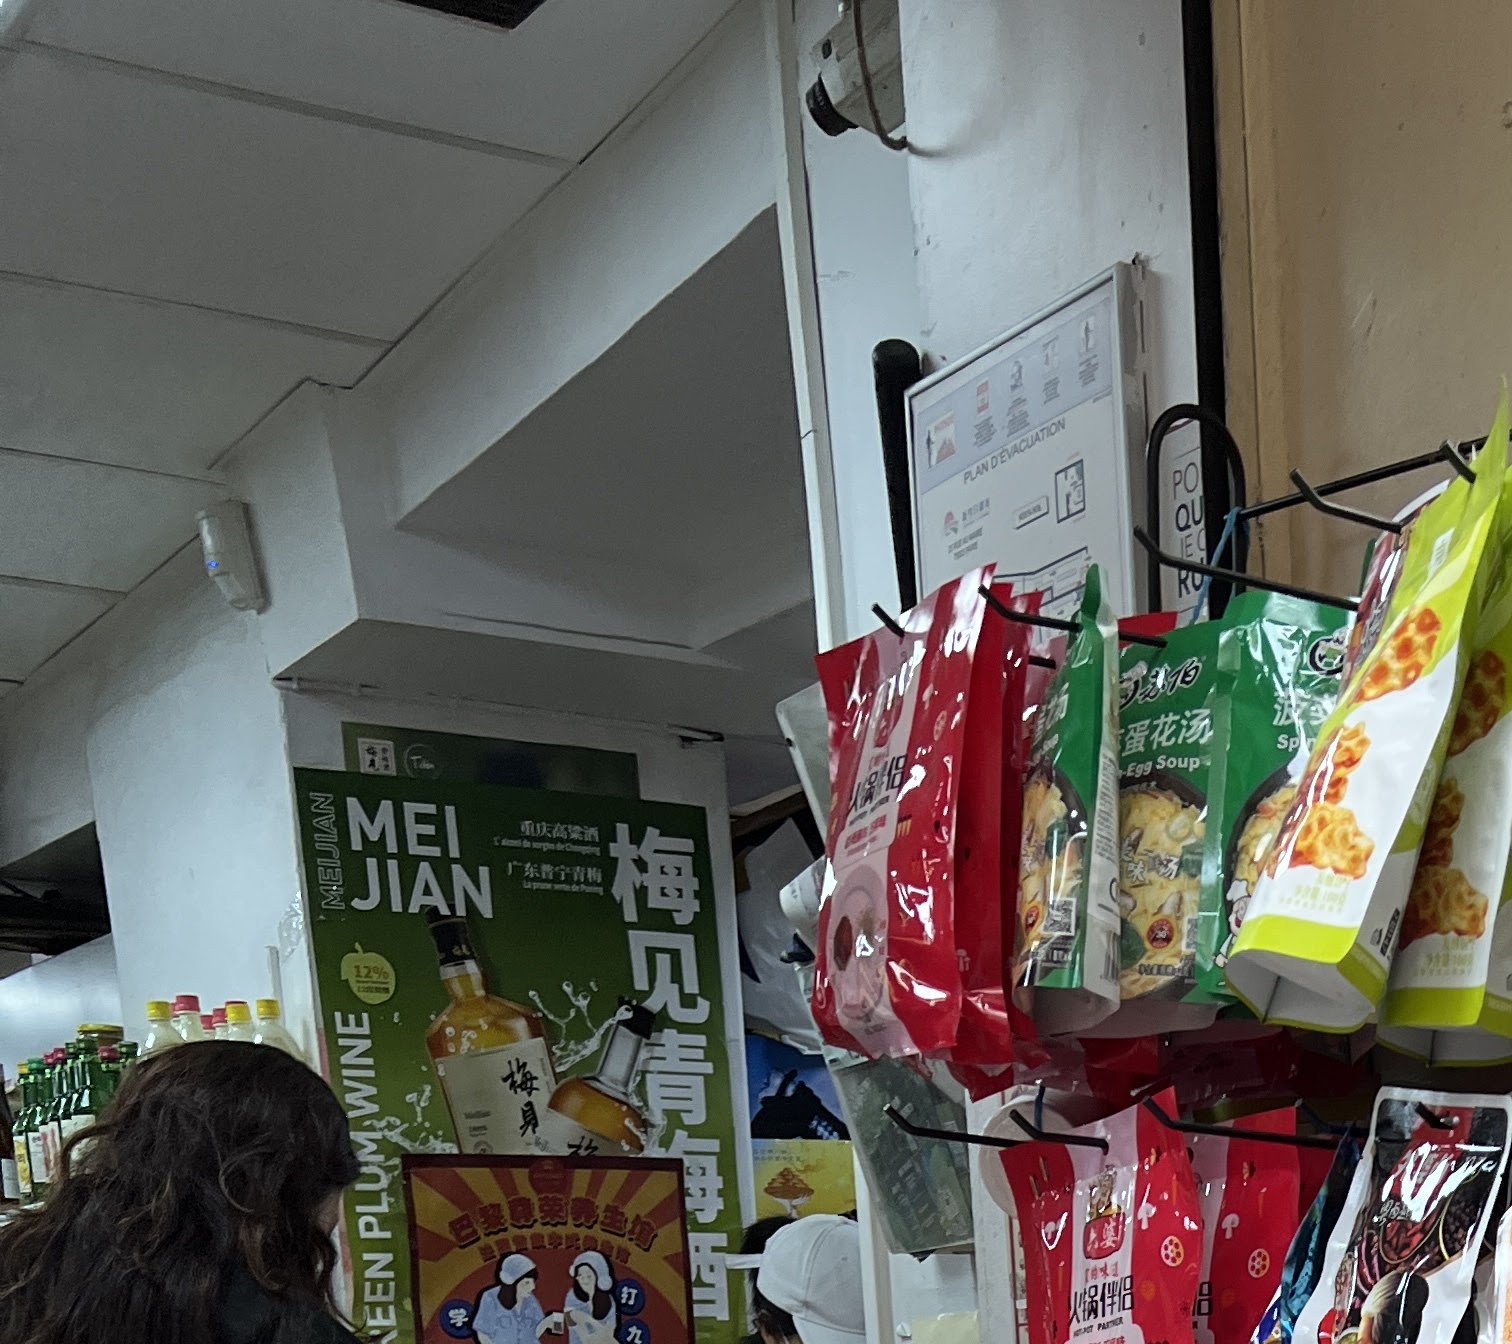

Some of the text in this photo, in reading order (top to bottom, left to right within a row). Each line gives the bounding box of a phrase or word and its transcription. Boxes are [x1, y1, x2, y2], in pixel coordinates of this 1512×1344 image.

[964, 458, 989, 484] PLAN
[1121, 708, 1214, 757] 蛋花汤
[1155, 755, 1201, 772] Soup
[309, 791, 347, 911] MEIJIAN
[346, 796, 461, 859] MEI
[351, 858, 494, 919] JIAN
[334, 1010, 376, 1119] WINE
[350, 1129, 397, 1243] PLUM
[1067, 1275, 1136, 1326] 火锅伴侣
